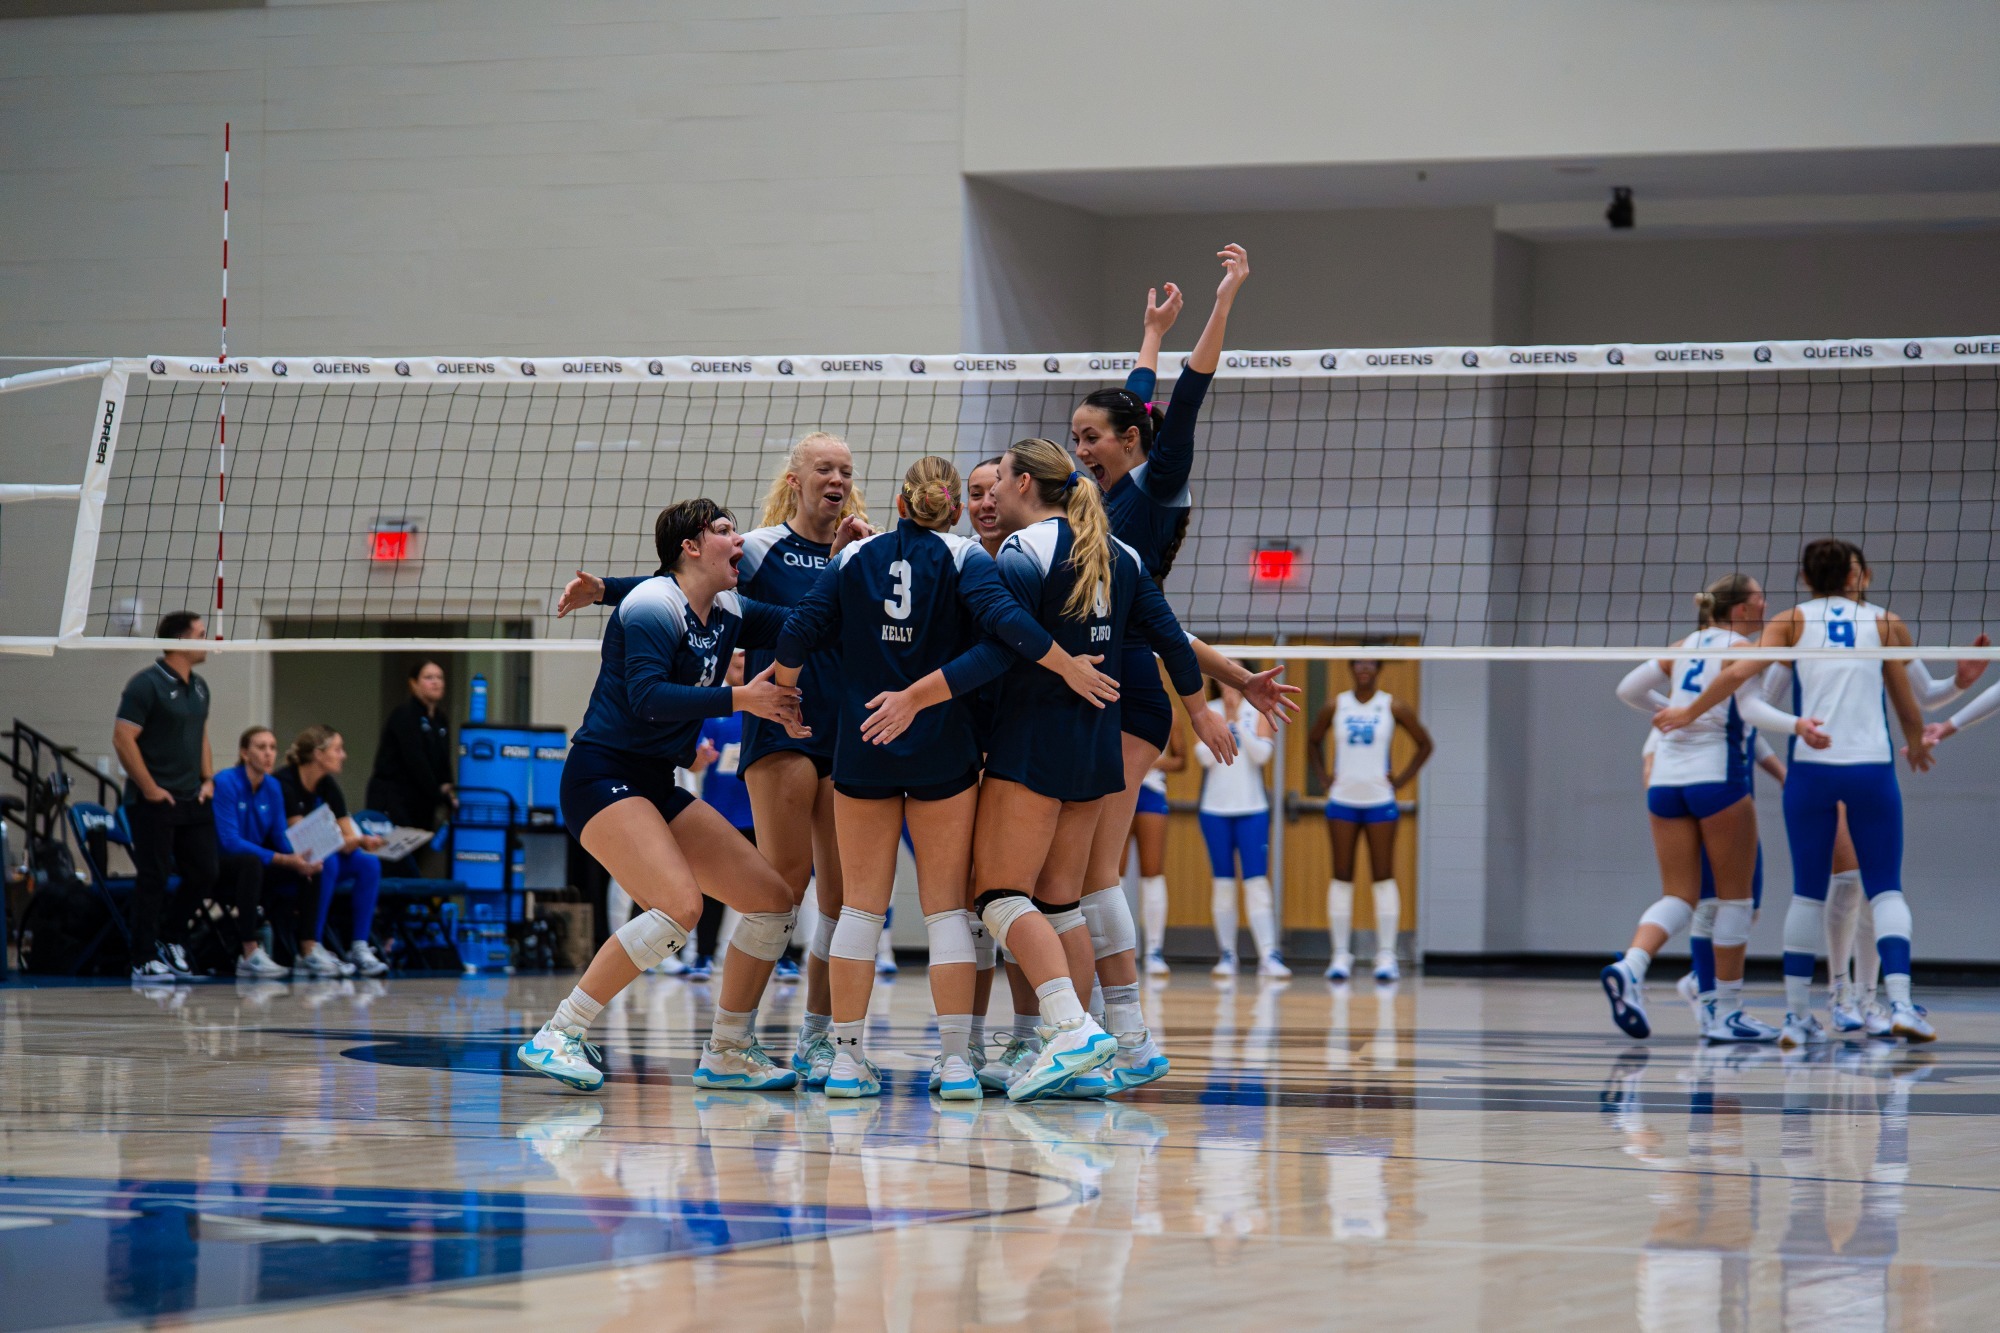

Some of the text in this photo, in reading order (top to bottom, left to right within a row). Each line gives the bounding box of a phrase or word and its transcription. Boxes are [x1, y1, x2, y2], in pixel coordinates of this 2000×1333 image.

[189, 362, 249, 374] QUEENS
[312, 362, 371, 375] QUEENS
[436, 362, 496, 375] QUEENS
[561, 362, 624, 375] QUEENS
[690, 361, 753, 374] QUEENS
[820, 360, 884, 373] QUEENS
[953, 360, 1017, 372] QUEENS
[1225, 356, 1293, 369] QUEENS
[1365, 354, 1434, 367] QUEENS
[1509, 351, 1578, 365] QUEENS
[1654, 348, 1725, 362] QUEENS
[1802, 345, 1874, 359] QUEENS
[783, 552, 829, 570] QUE
[884, 560, 912, 620] 3
[881, 624, 914, 643] KELLY
[1828, 619, 1856, 648] 9
[1681, 658, 1706, 693] 2
